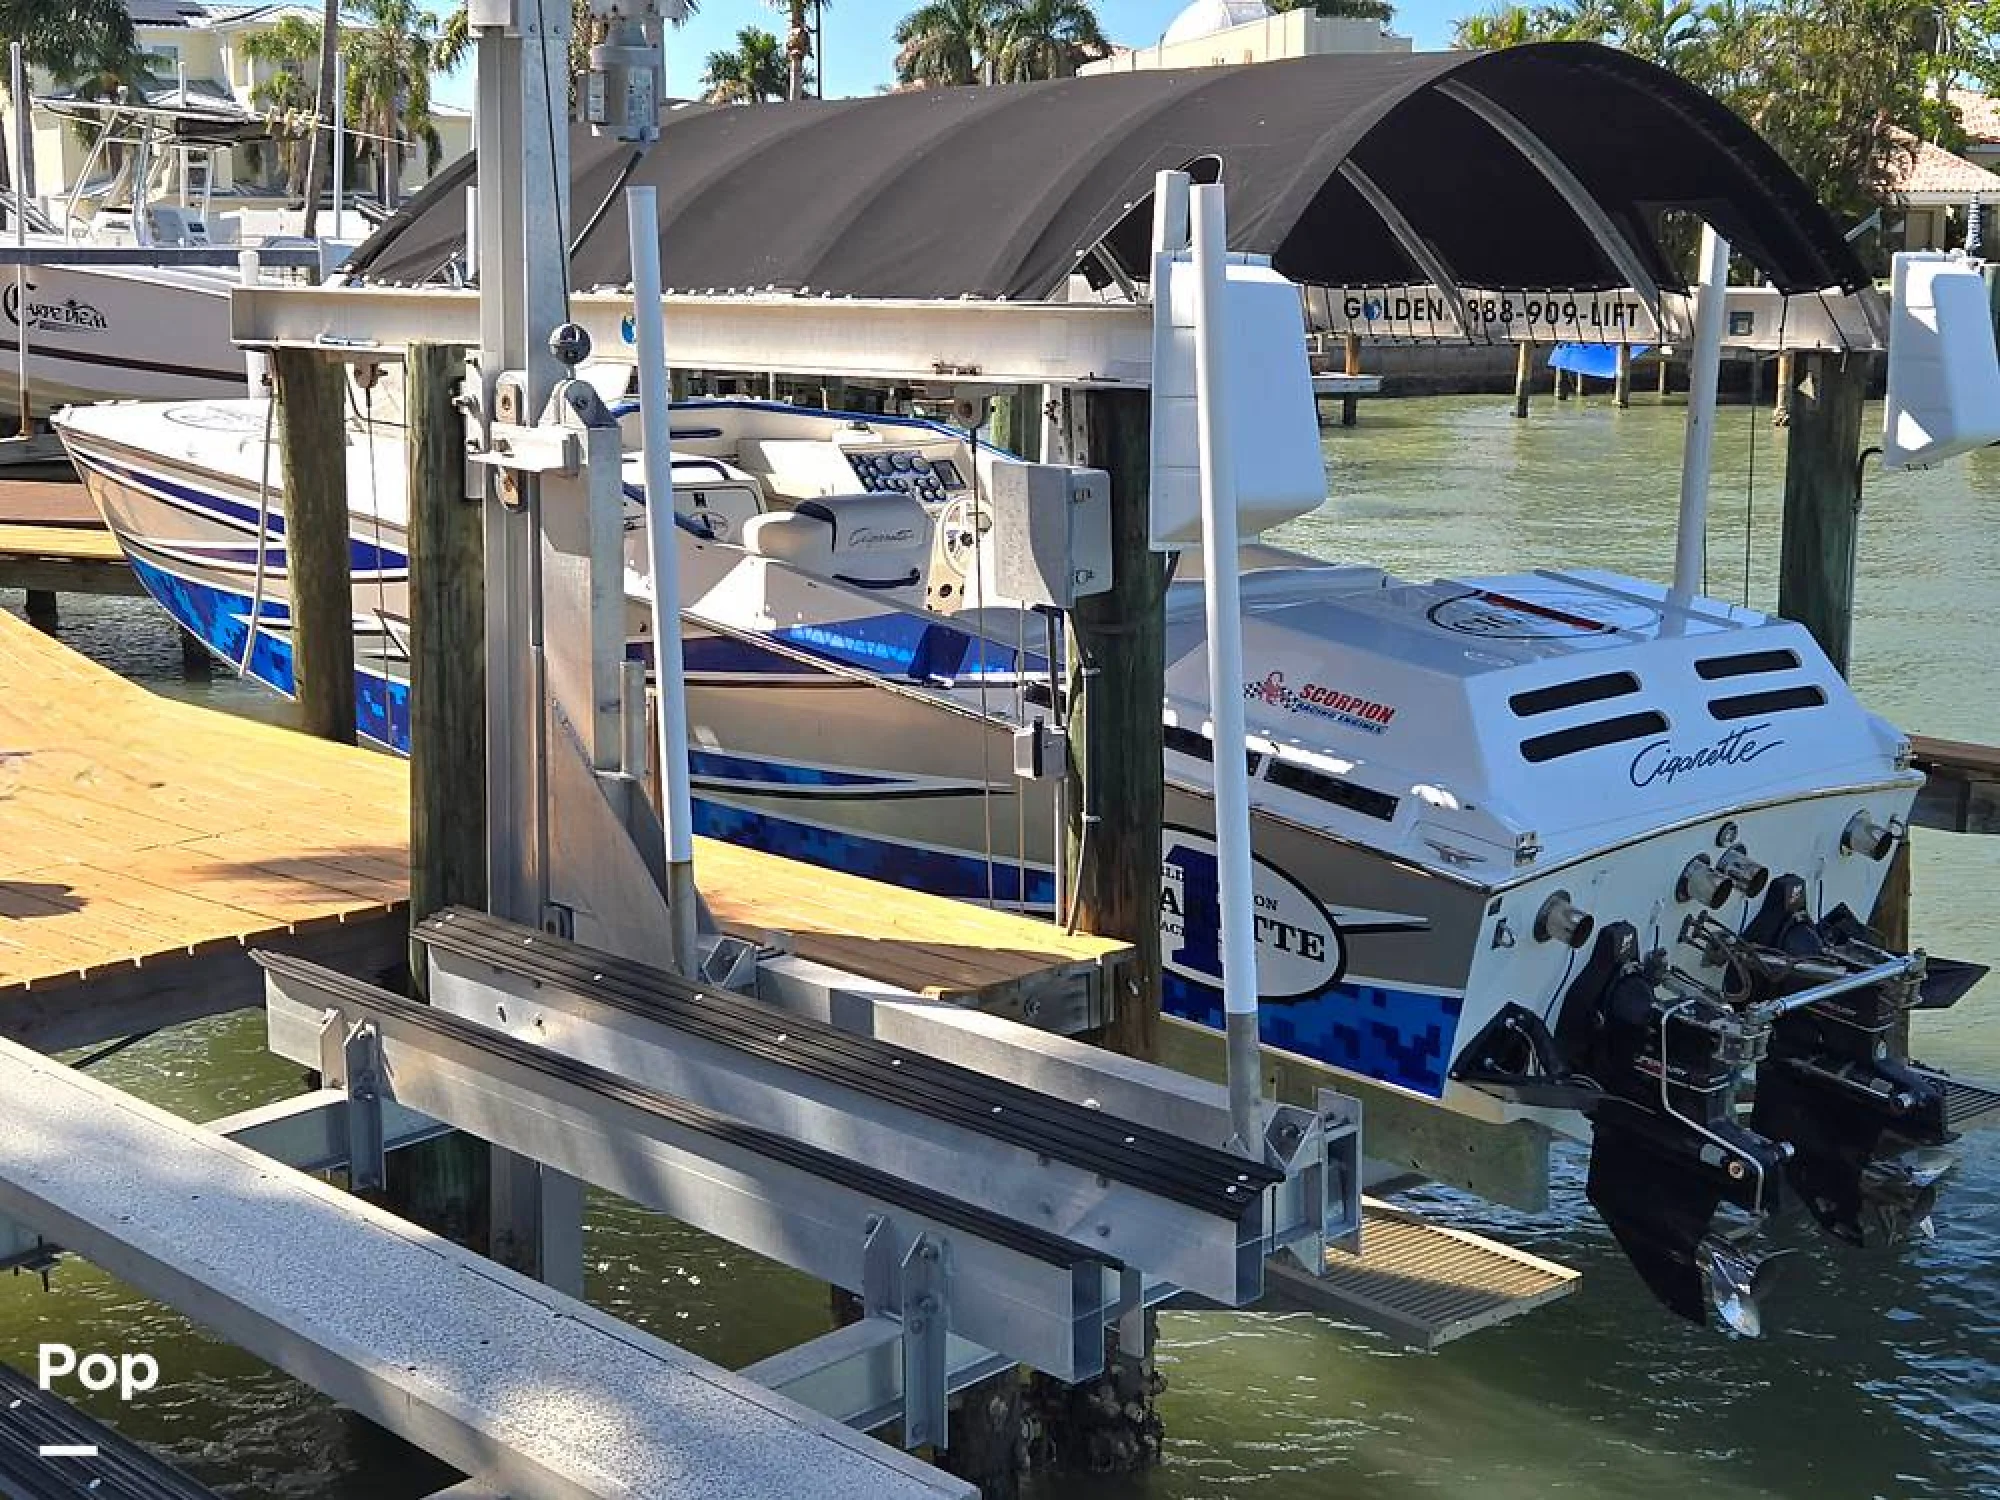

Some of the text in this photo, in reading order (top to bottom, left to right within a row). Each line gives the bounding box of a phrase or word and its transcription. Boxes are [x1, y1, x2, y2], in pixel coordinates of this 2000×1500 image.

[1344, 297, 1443, 322] GOLDEN
[1300, 683, 1396, 724] SCORPION
[1629, 722, 1785, 788] Cigarette
